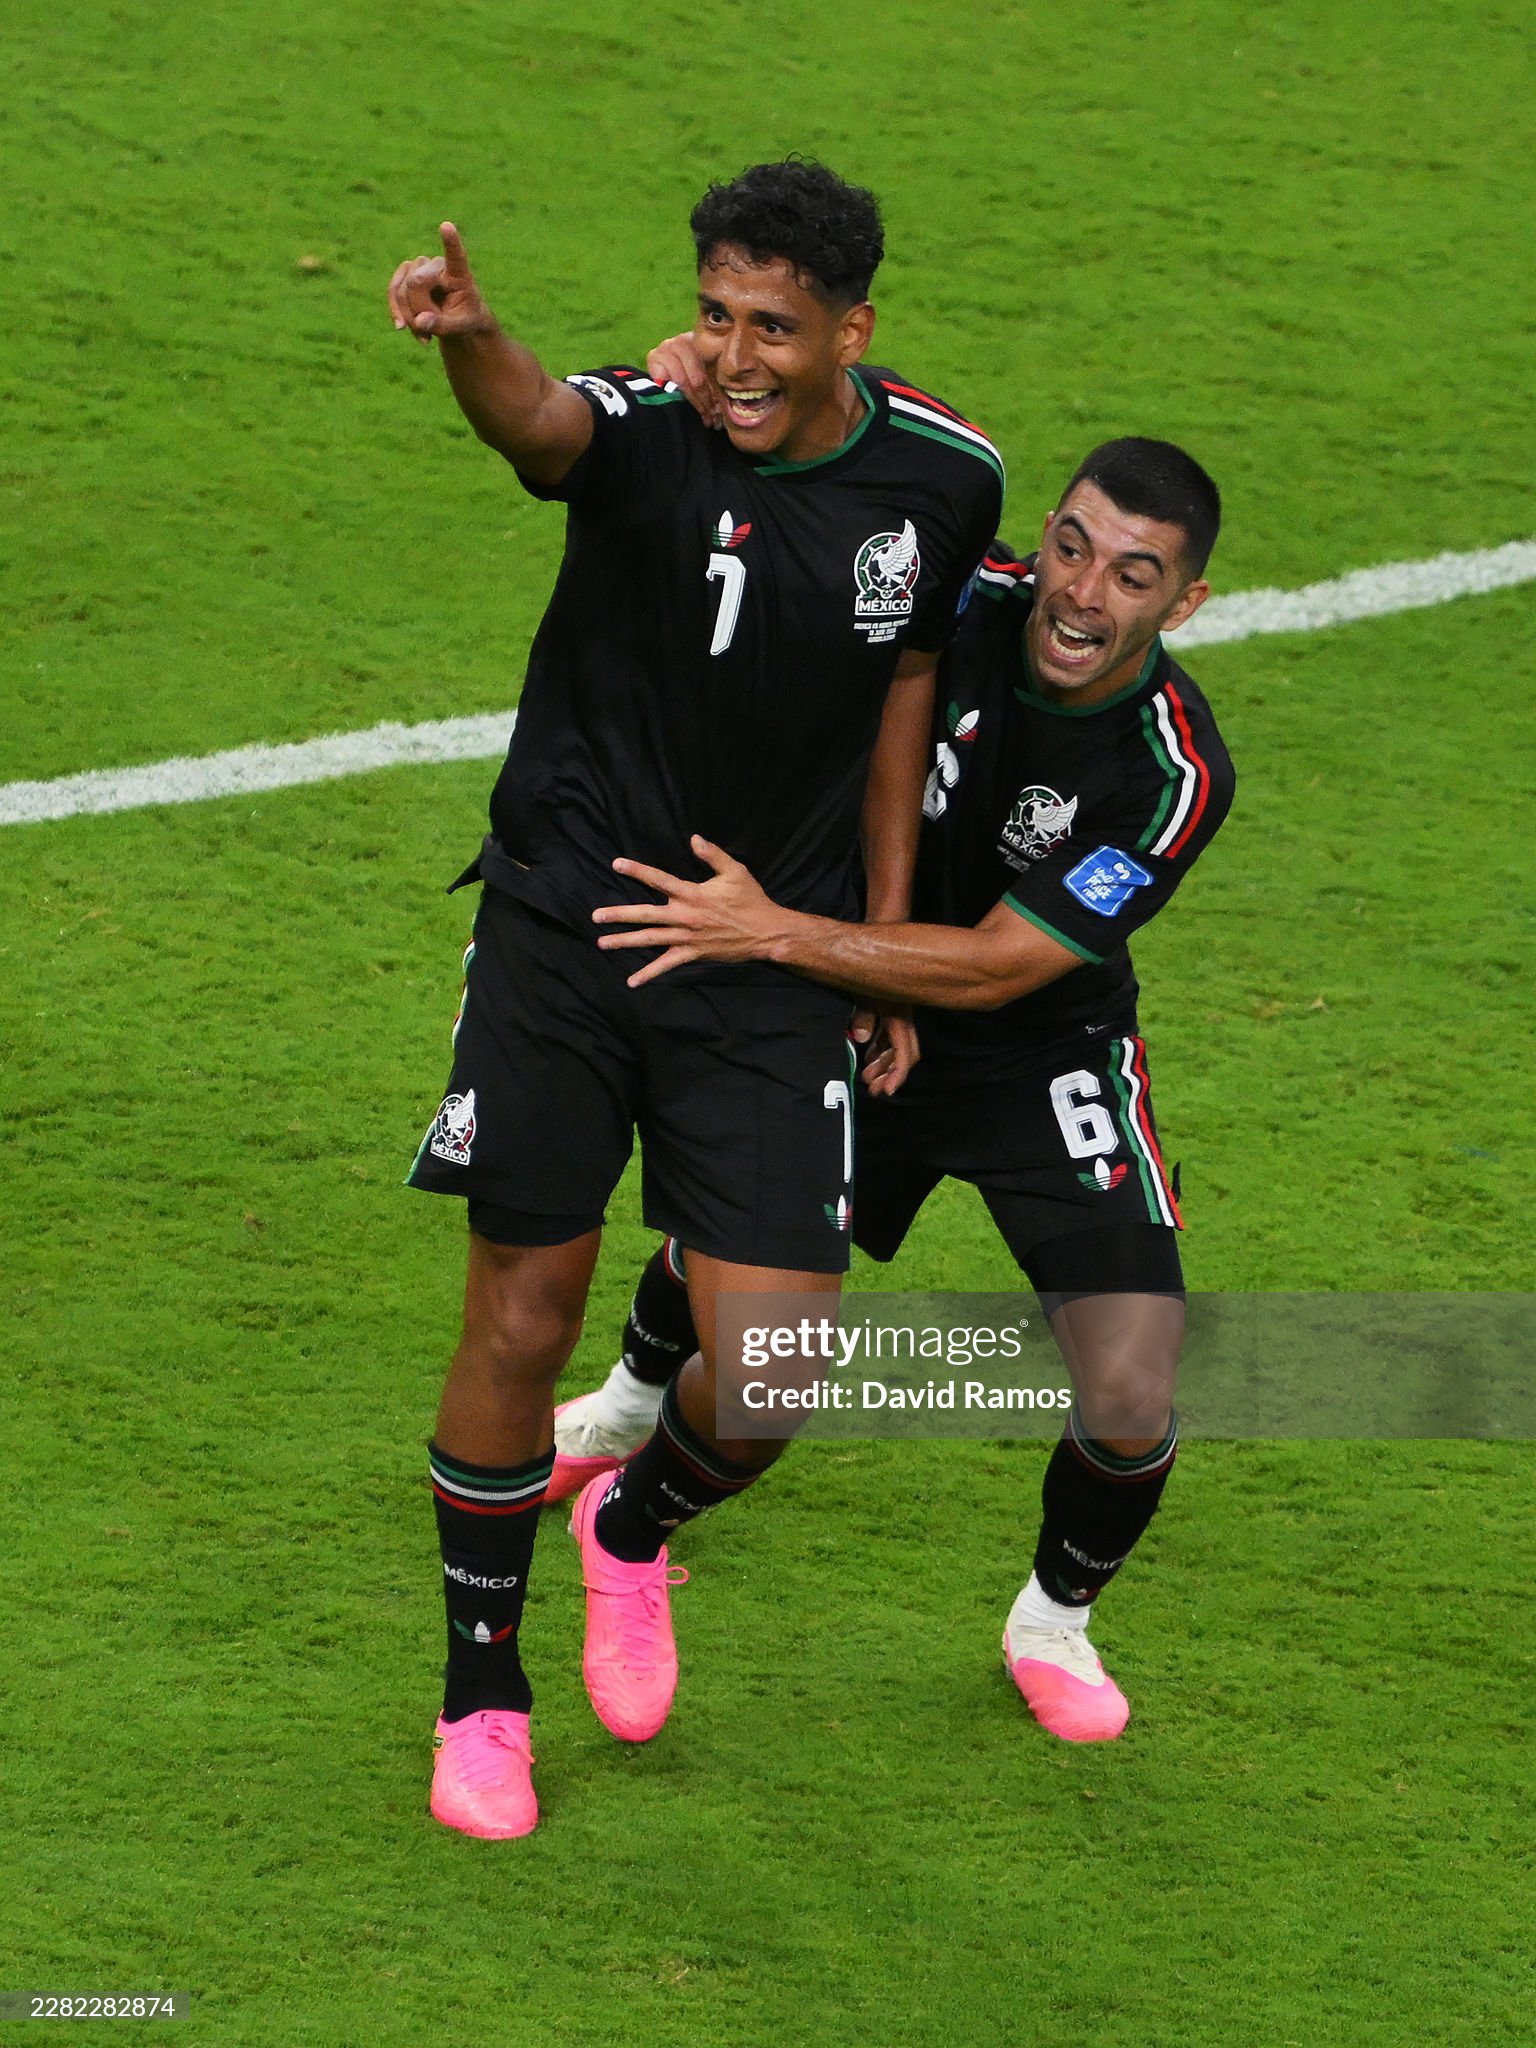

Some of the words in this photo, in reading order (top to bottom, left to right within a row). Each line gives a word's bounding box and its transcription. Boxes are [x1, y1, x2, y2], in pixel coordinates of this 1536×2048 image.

[705, 553, 747, 656] 7
[858, 597, 911, 612] MÉXICO
[1049, 1069, 1119, 1159] 6
[823, 1080, 852, 1184] 7
[432, 1140, 468, 1162] MÉXICO
[1063, 1539, 1125, 1570] MÉXIC
[443, 1563, 518, 1589] MÉXICO
